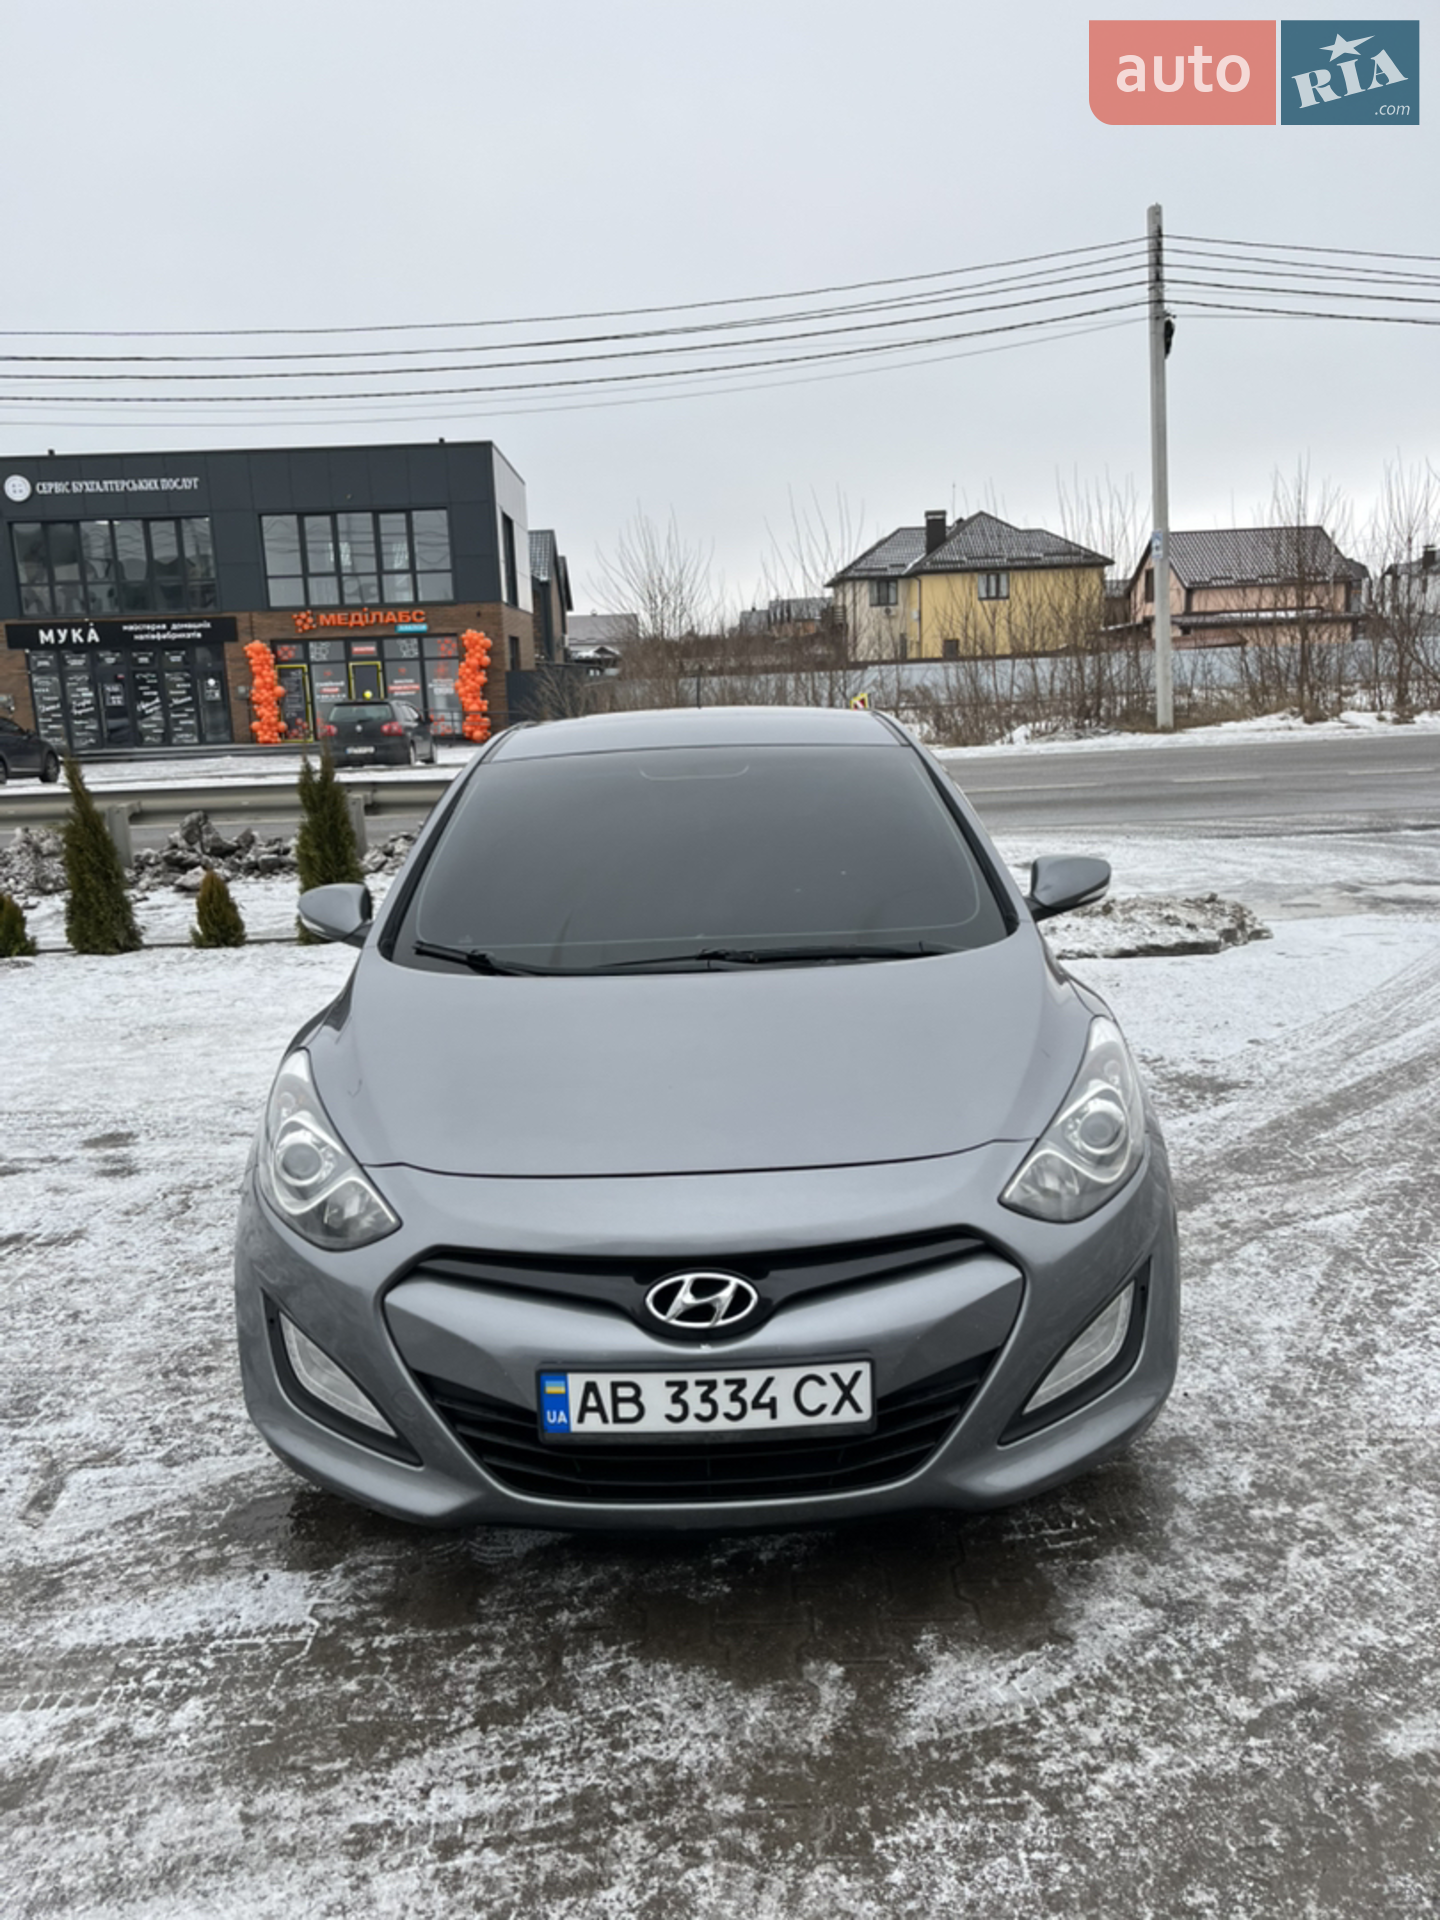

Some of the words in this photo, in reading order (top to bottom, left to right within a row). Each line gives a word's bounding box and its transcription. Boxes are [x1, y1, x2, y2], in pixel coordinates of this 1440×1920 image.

[36, 480, 71, 495] СЕРВІС
[72, 478, 160, 494] БУХГАЛТЕРСЬКИХ
[160, 477, 200, 491] ПОСЛУГ
[576, 1380, 646, 1425] AB
[664, 1376, 778, 1424] 3334
[793, 1369, 864, 1418] CX
[546, 1410, 568, 1424] UA
